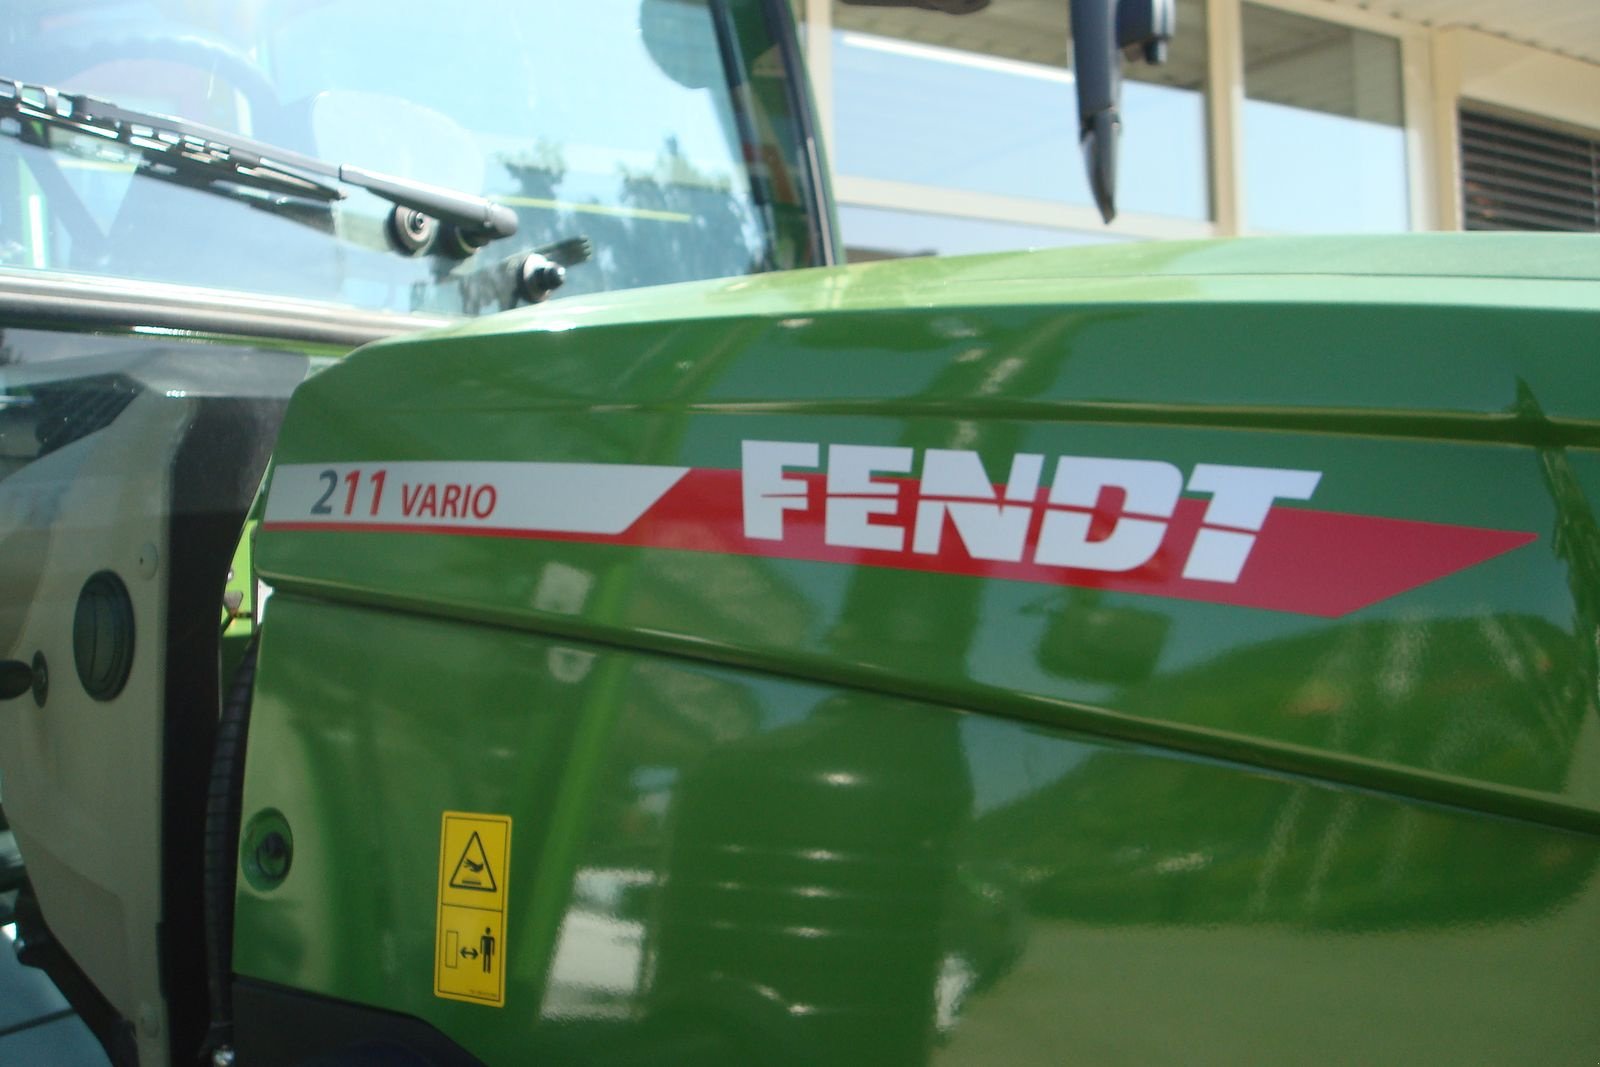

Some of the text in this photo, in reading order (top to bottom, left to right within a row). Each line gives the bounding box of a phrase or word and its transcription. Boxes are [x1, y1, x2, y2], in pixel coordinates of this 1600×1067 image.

[310, 469, 497, 519] 211 VARIO
[741, 439, 1322, 584] FENDT
